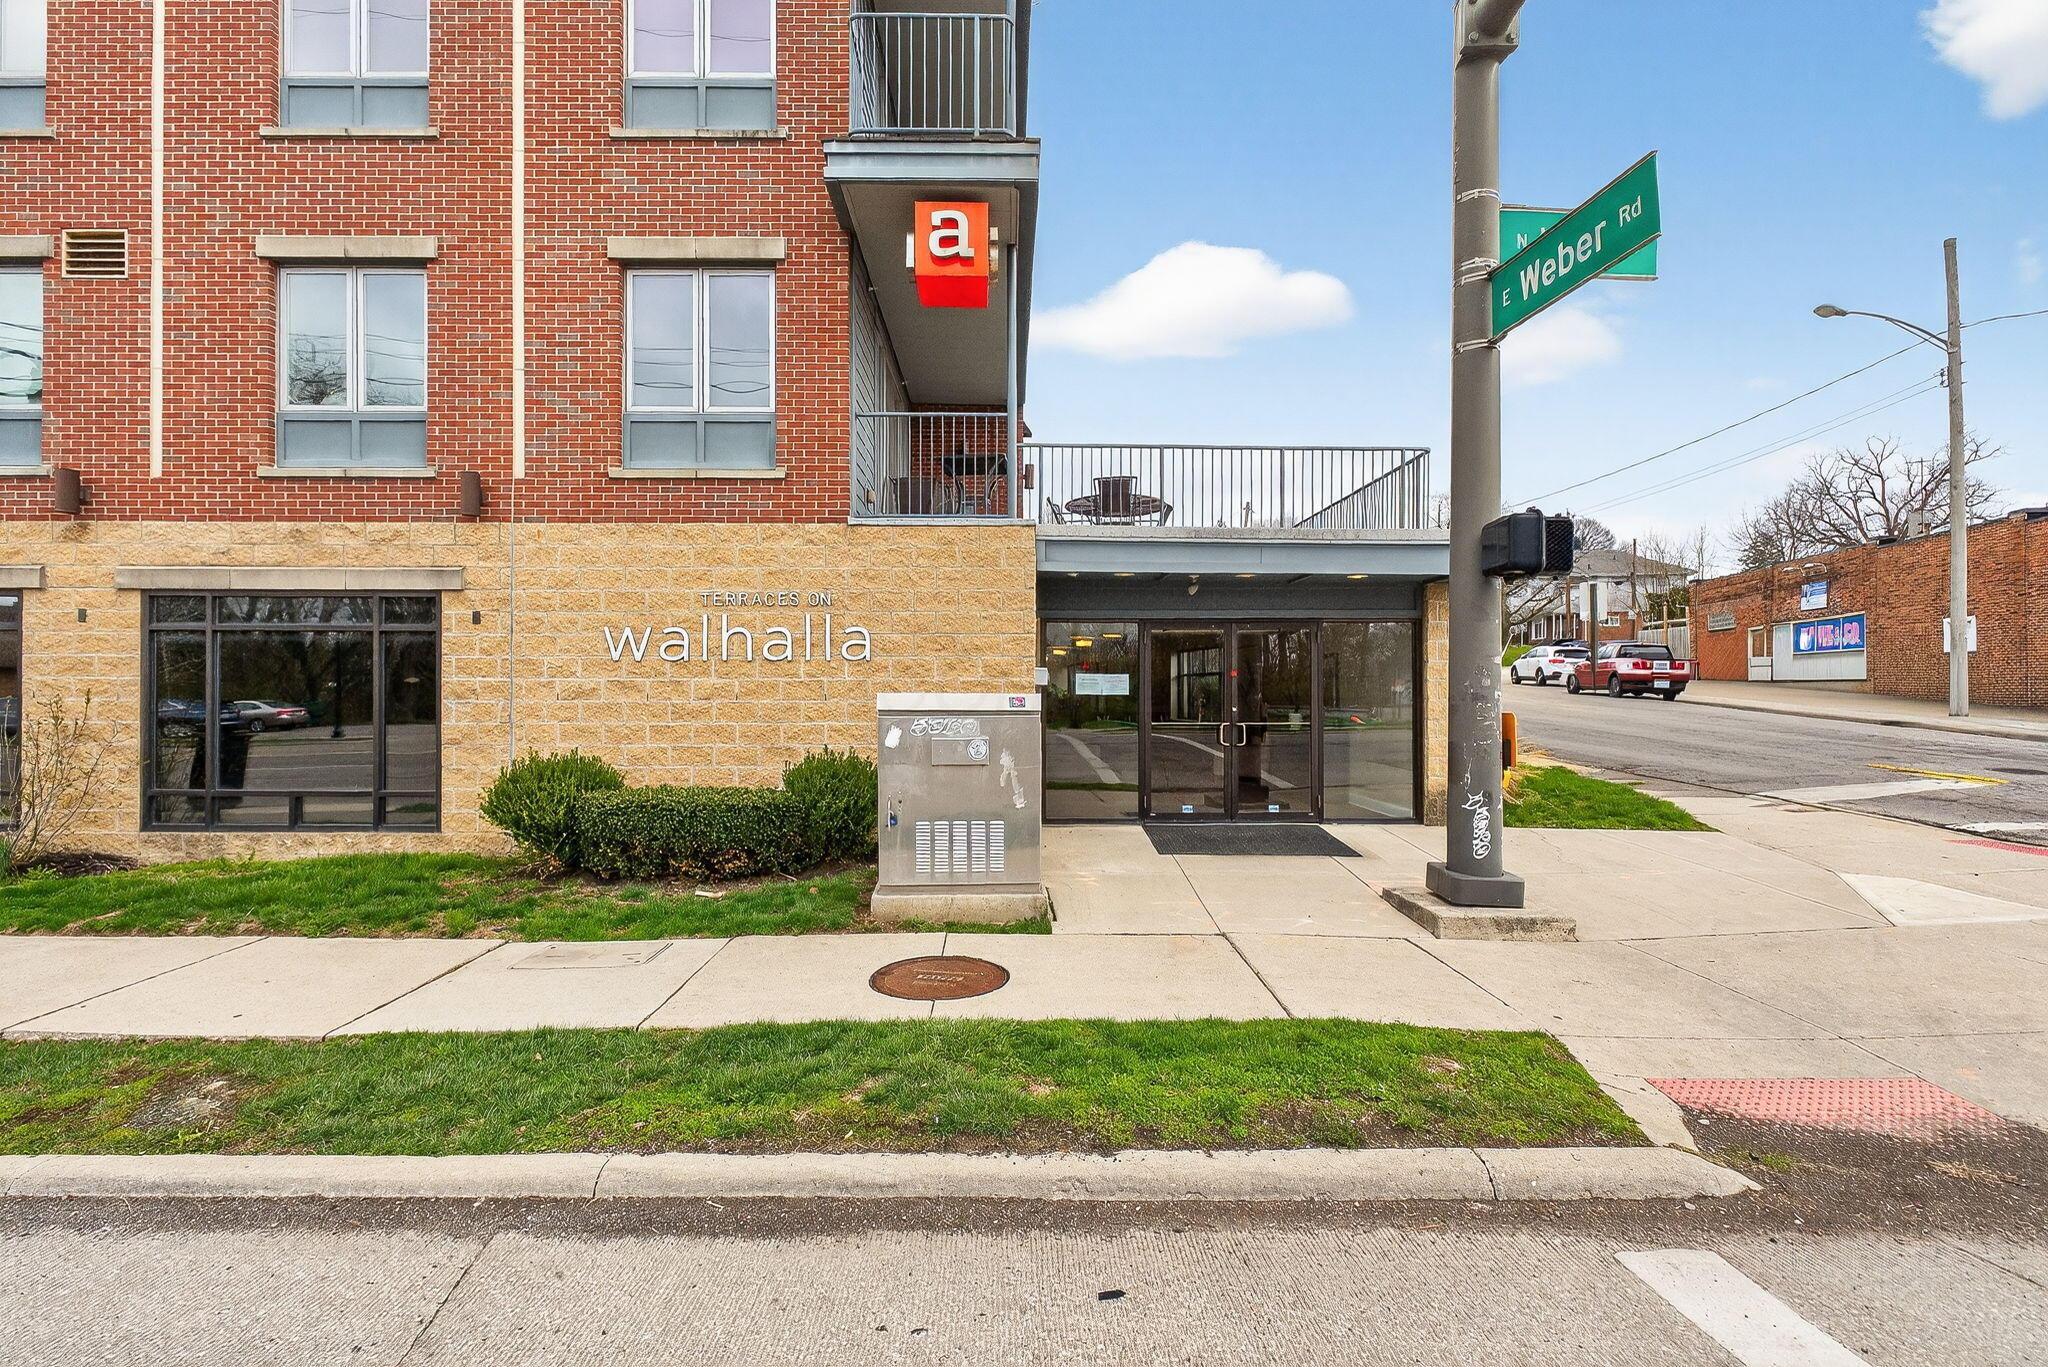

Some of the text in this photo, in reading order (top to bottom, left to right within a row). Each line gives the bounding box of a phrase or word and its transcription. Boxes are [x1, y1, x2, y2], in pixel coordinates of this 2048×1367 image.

[929, 209, 975, 258] a
[1502, 195, 1642, 308] E Weber Rd
[1516, 233, 1528, 250] N
[701, 591, 833, 607] TERRACES ON
[603, 613, 873, 663] walhalla
